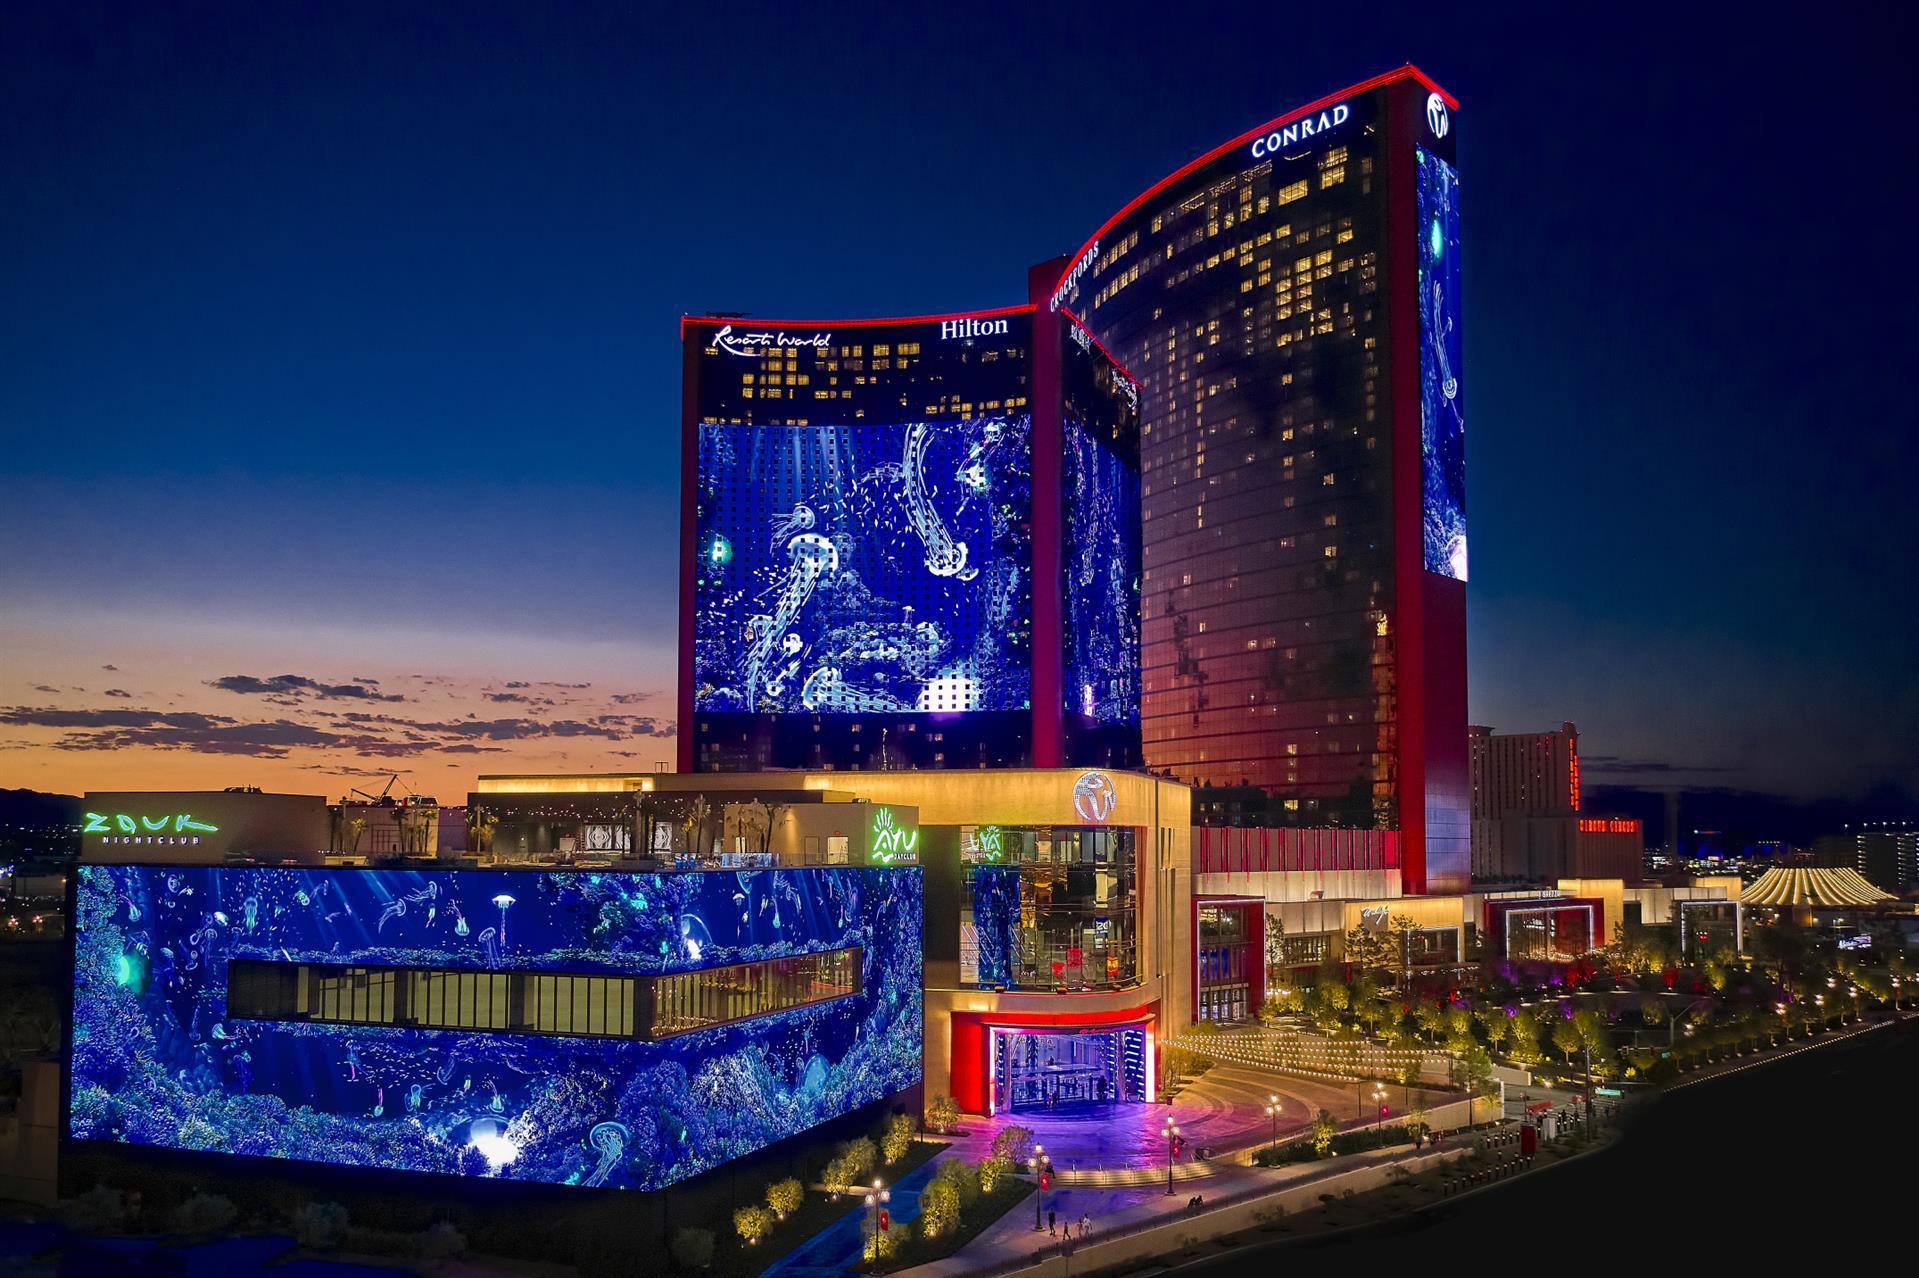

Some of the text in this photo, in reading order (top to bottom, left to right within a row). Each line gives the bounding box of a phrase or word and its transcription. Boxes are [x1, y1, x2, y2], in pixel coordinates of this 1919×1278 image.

[1251, 104, 1349, 158] CONRAD
[1050, 240, 1099, 313] CROCKFORDS
[941, 318, 1008, 340] Hilton
[712, 325, 831, 357] Resorts World
[84, 812, 219, 834] ZOUK
[103, 836, 200, 845] NIGHTCLUB
[873, 828, 917, 851] AYU
